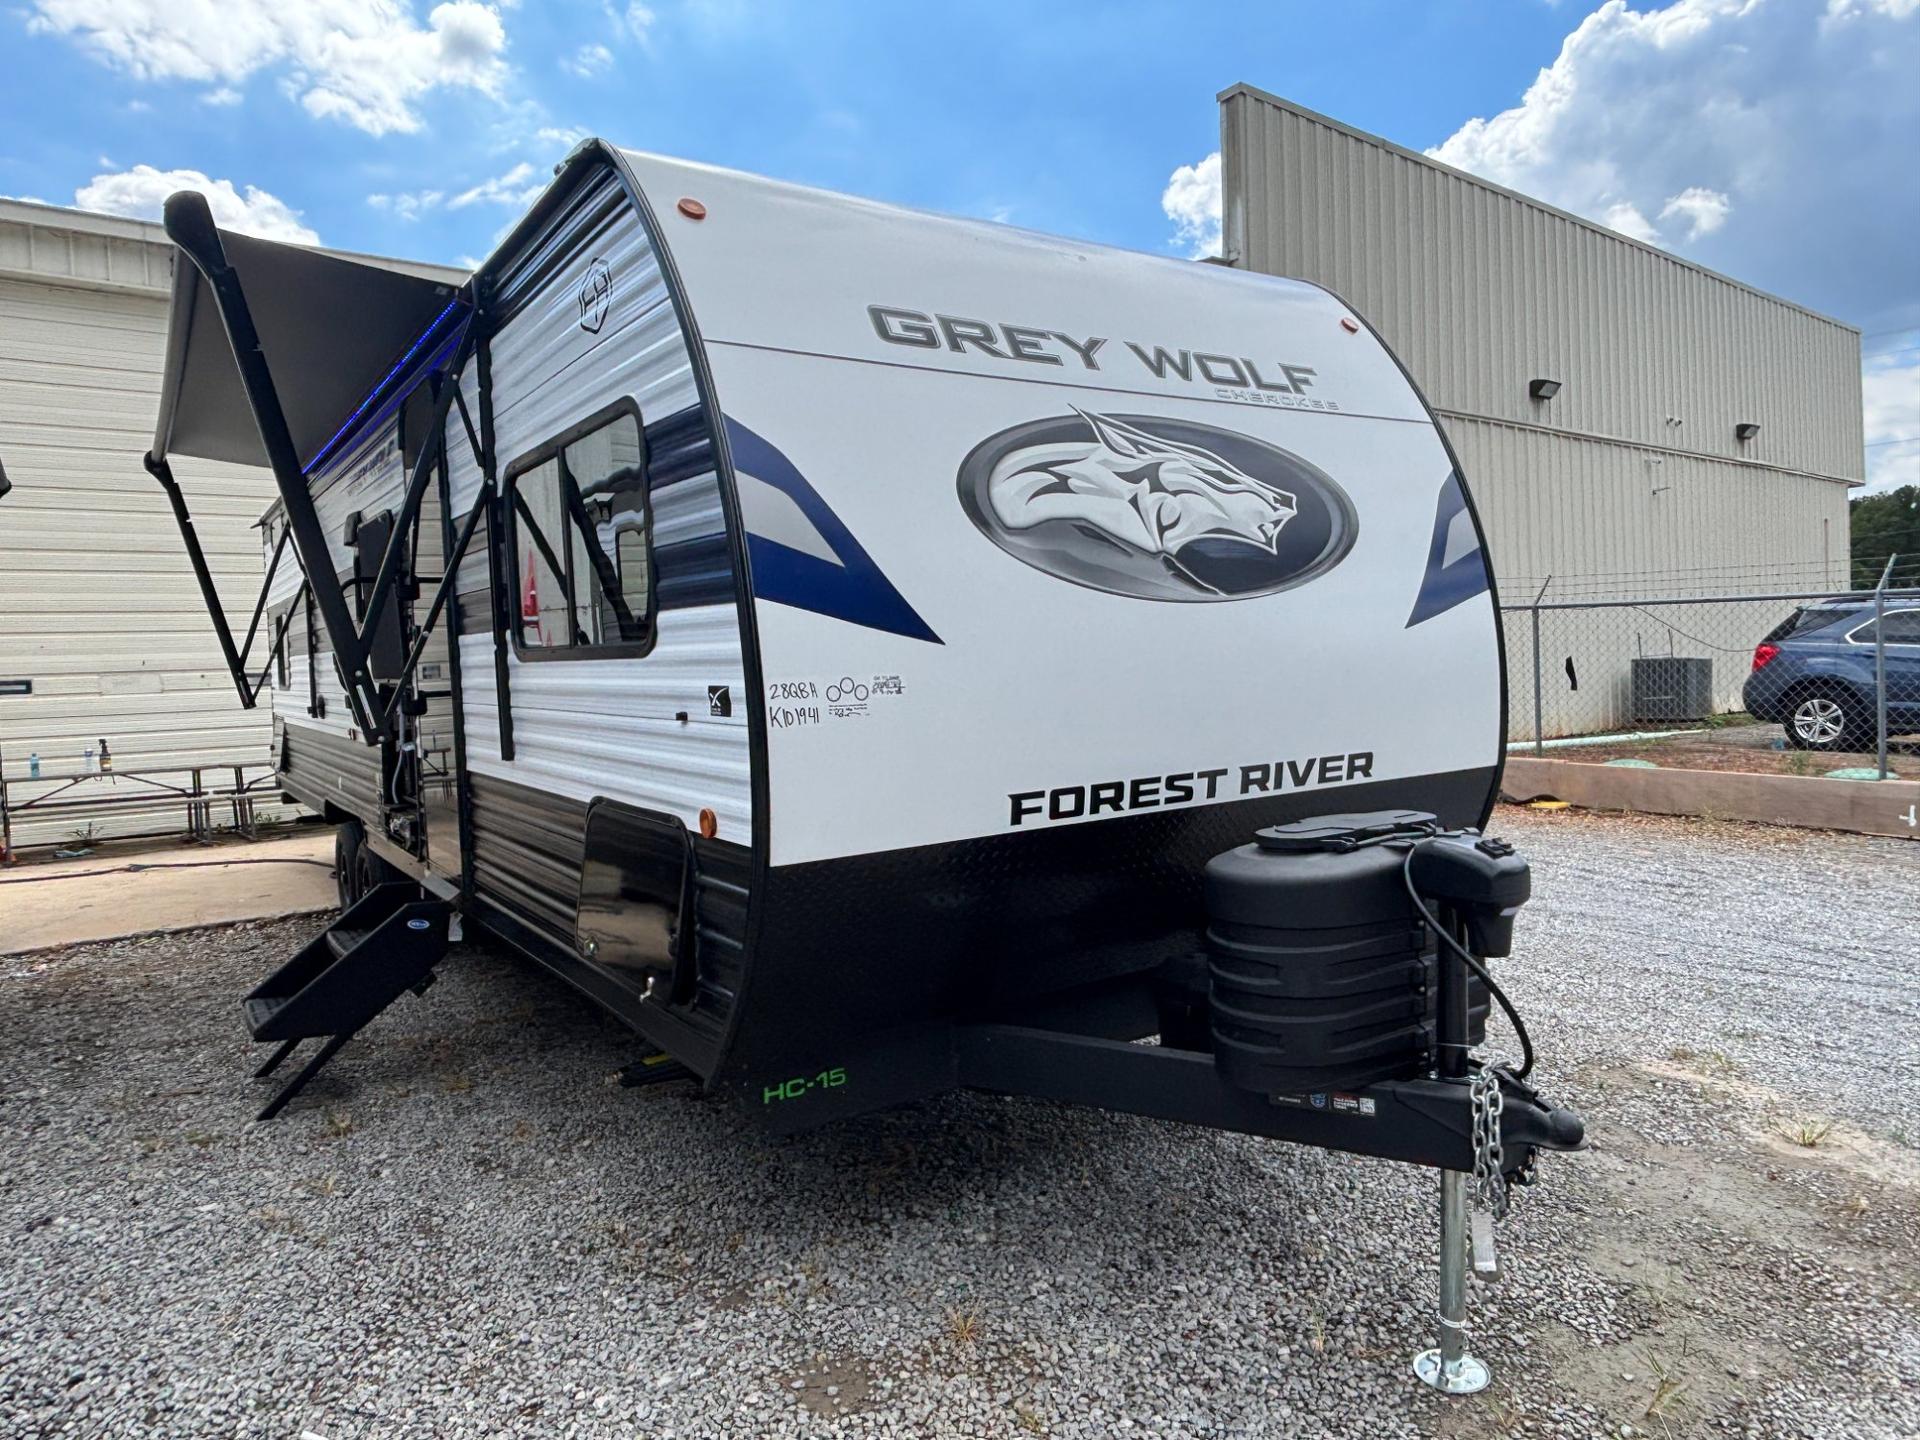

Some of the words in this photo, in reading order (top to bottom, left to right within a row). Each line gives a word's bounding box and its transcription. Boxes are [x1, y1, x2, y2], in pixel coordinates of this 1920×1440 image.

[867, 304, 1109, 371] GREY
[1124, 341, 1318, 395] WOLF
[1215, 388, 1340, 411] CHEROKEE
[1007, 768, 1229, 827] FOREST
[1239, 751, 1374, 795] RIVER
[763, 1067, 846, 1105] HC-15
